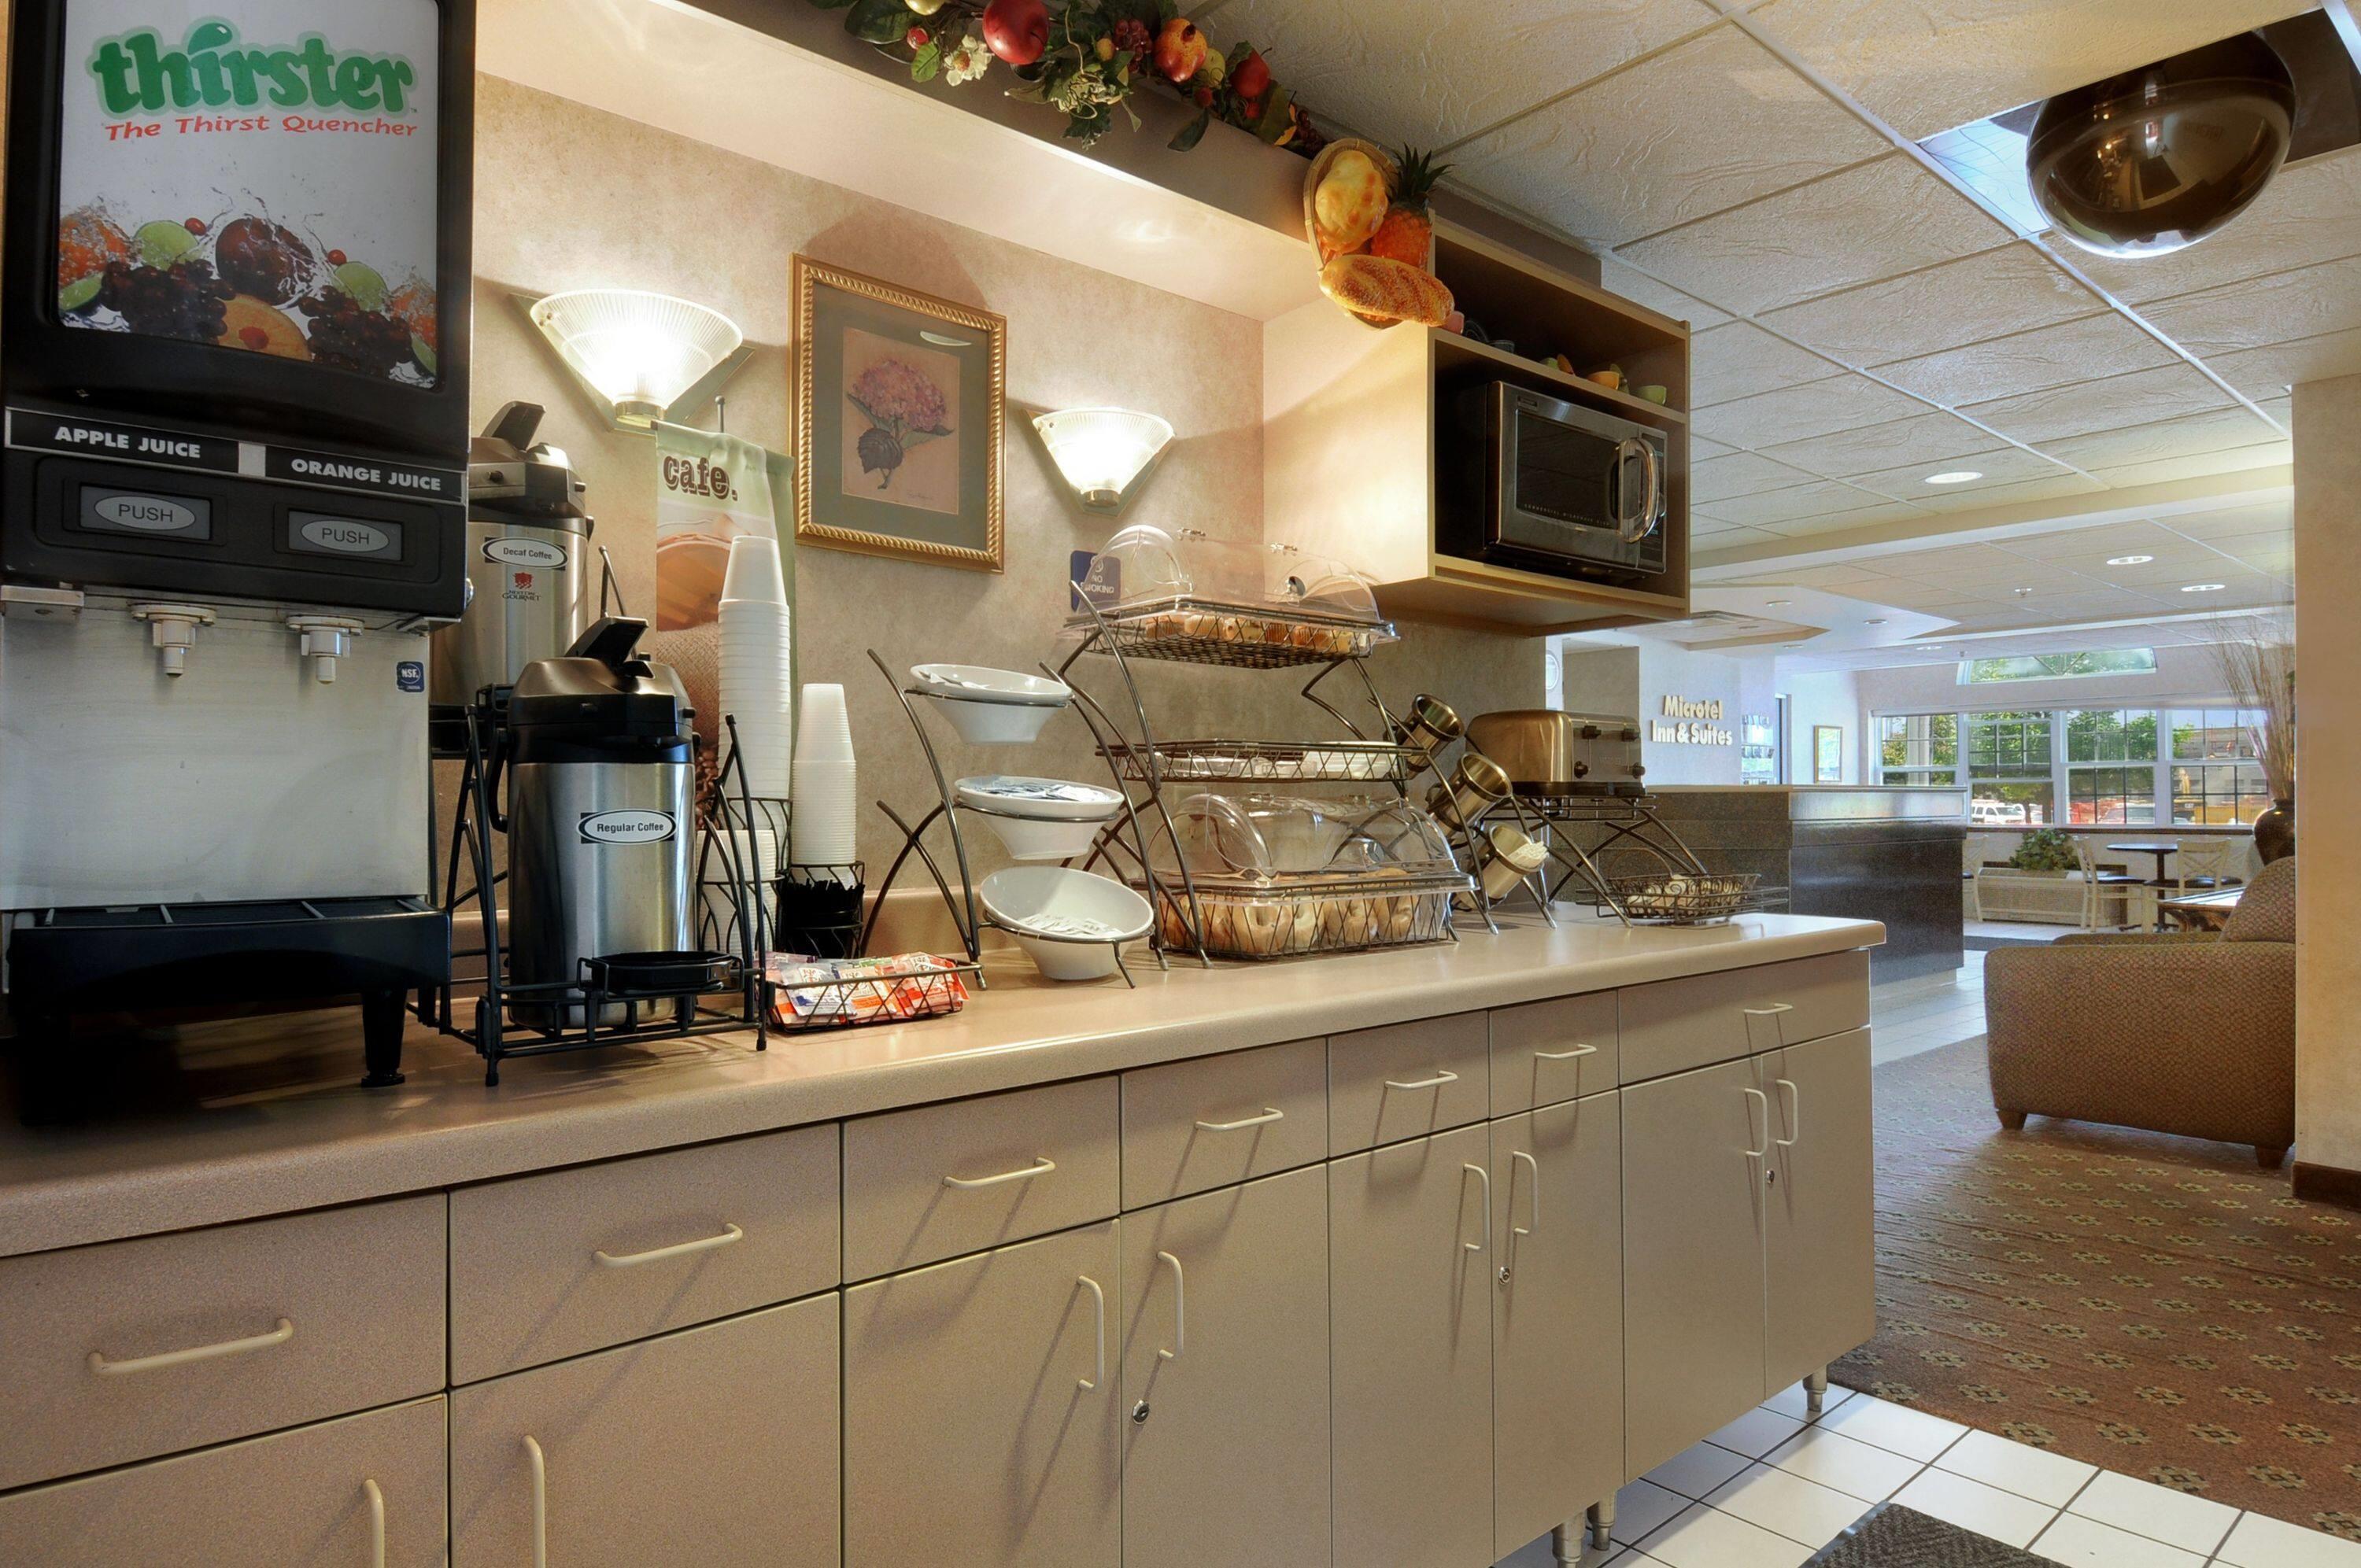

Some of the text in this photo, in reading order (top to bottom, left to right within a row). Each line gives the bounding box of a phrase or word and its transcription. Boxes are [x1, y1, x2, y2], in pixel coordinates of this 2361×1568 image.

[92, 22, 414, 113] thirster
[105, 115, 418, 141] The Thirst Quencher
[54, 426, 201, 459] APPLE JUICE
[291, 458, 442, 492] ORANGE JUICE
[117, 504, 173, 523] PUSH
[321, 526, 370, 545] PUSH
[503, 547, 553, 560] Decaf Coffee
[1662, 695, 1724, 720] Microtel
[1650, 718, 1733, 746] Inn & Suites
[597, 822, 664, 834] Regular Coffee
